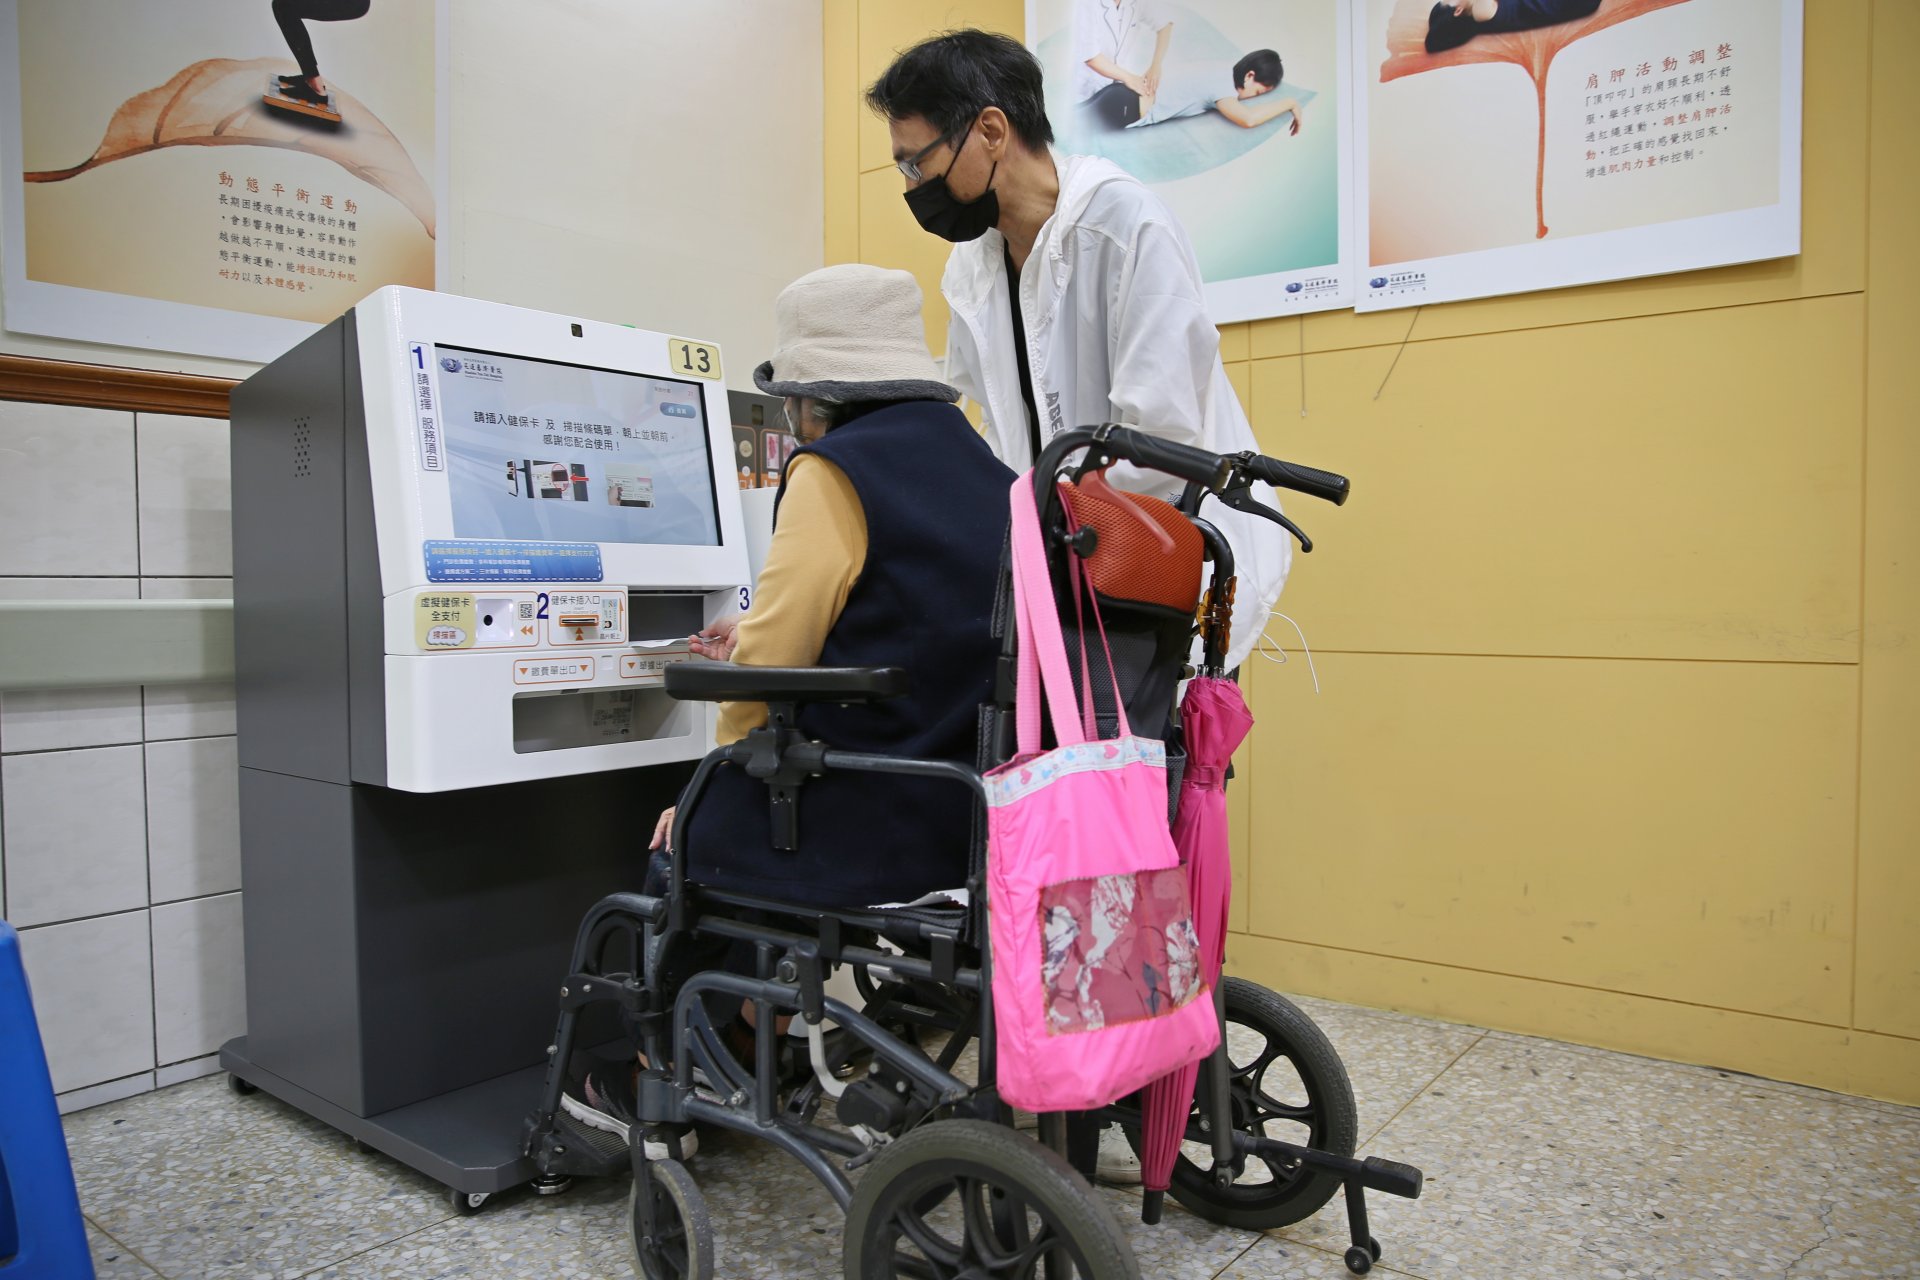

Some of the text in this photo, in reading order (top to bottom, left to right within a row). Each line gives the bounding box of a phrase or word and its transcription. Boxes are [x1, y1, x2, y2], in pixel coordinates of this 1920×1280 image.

[1585, 42, 1733, 90] 肩胛活動調整
[218, 171, 357, 215] 動態平衡運動
[412, 346, 424, 369] 1
[681, 344, 711, 373] 13
[474, 411, 540, 428] 請插入健保卡
[546, 418, 556, 431] 及
[422, 417, 438, 468] 服務項目
[421, 597, 470, 608] 虛擬健保卡
[536, 592, 549, 620] 2
[551, 595, 600, 605] 健保卡插入口
[740, 587, 750, 610] 3
[431, 611, 461, 622] 全支付
